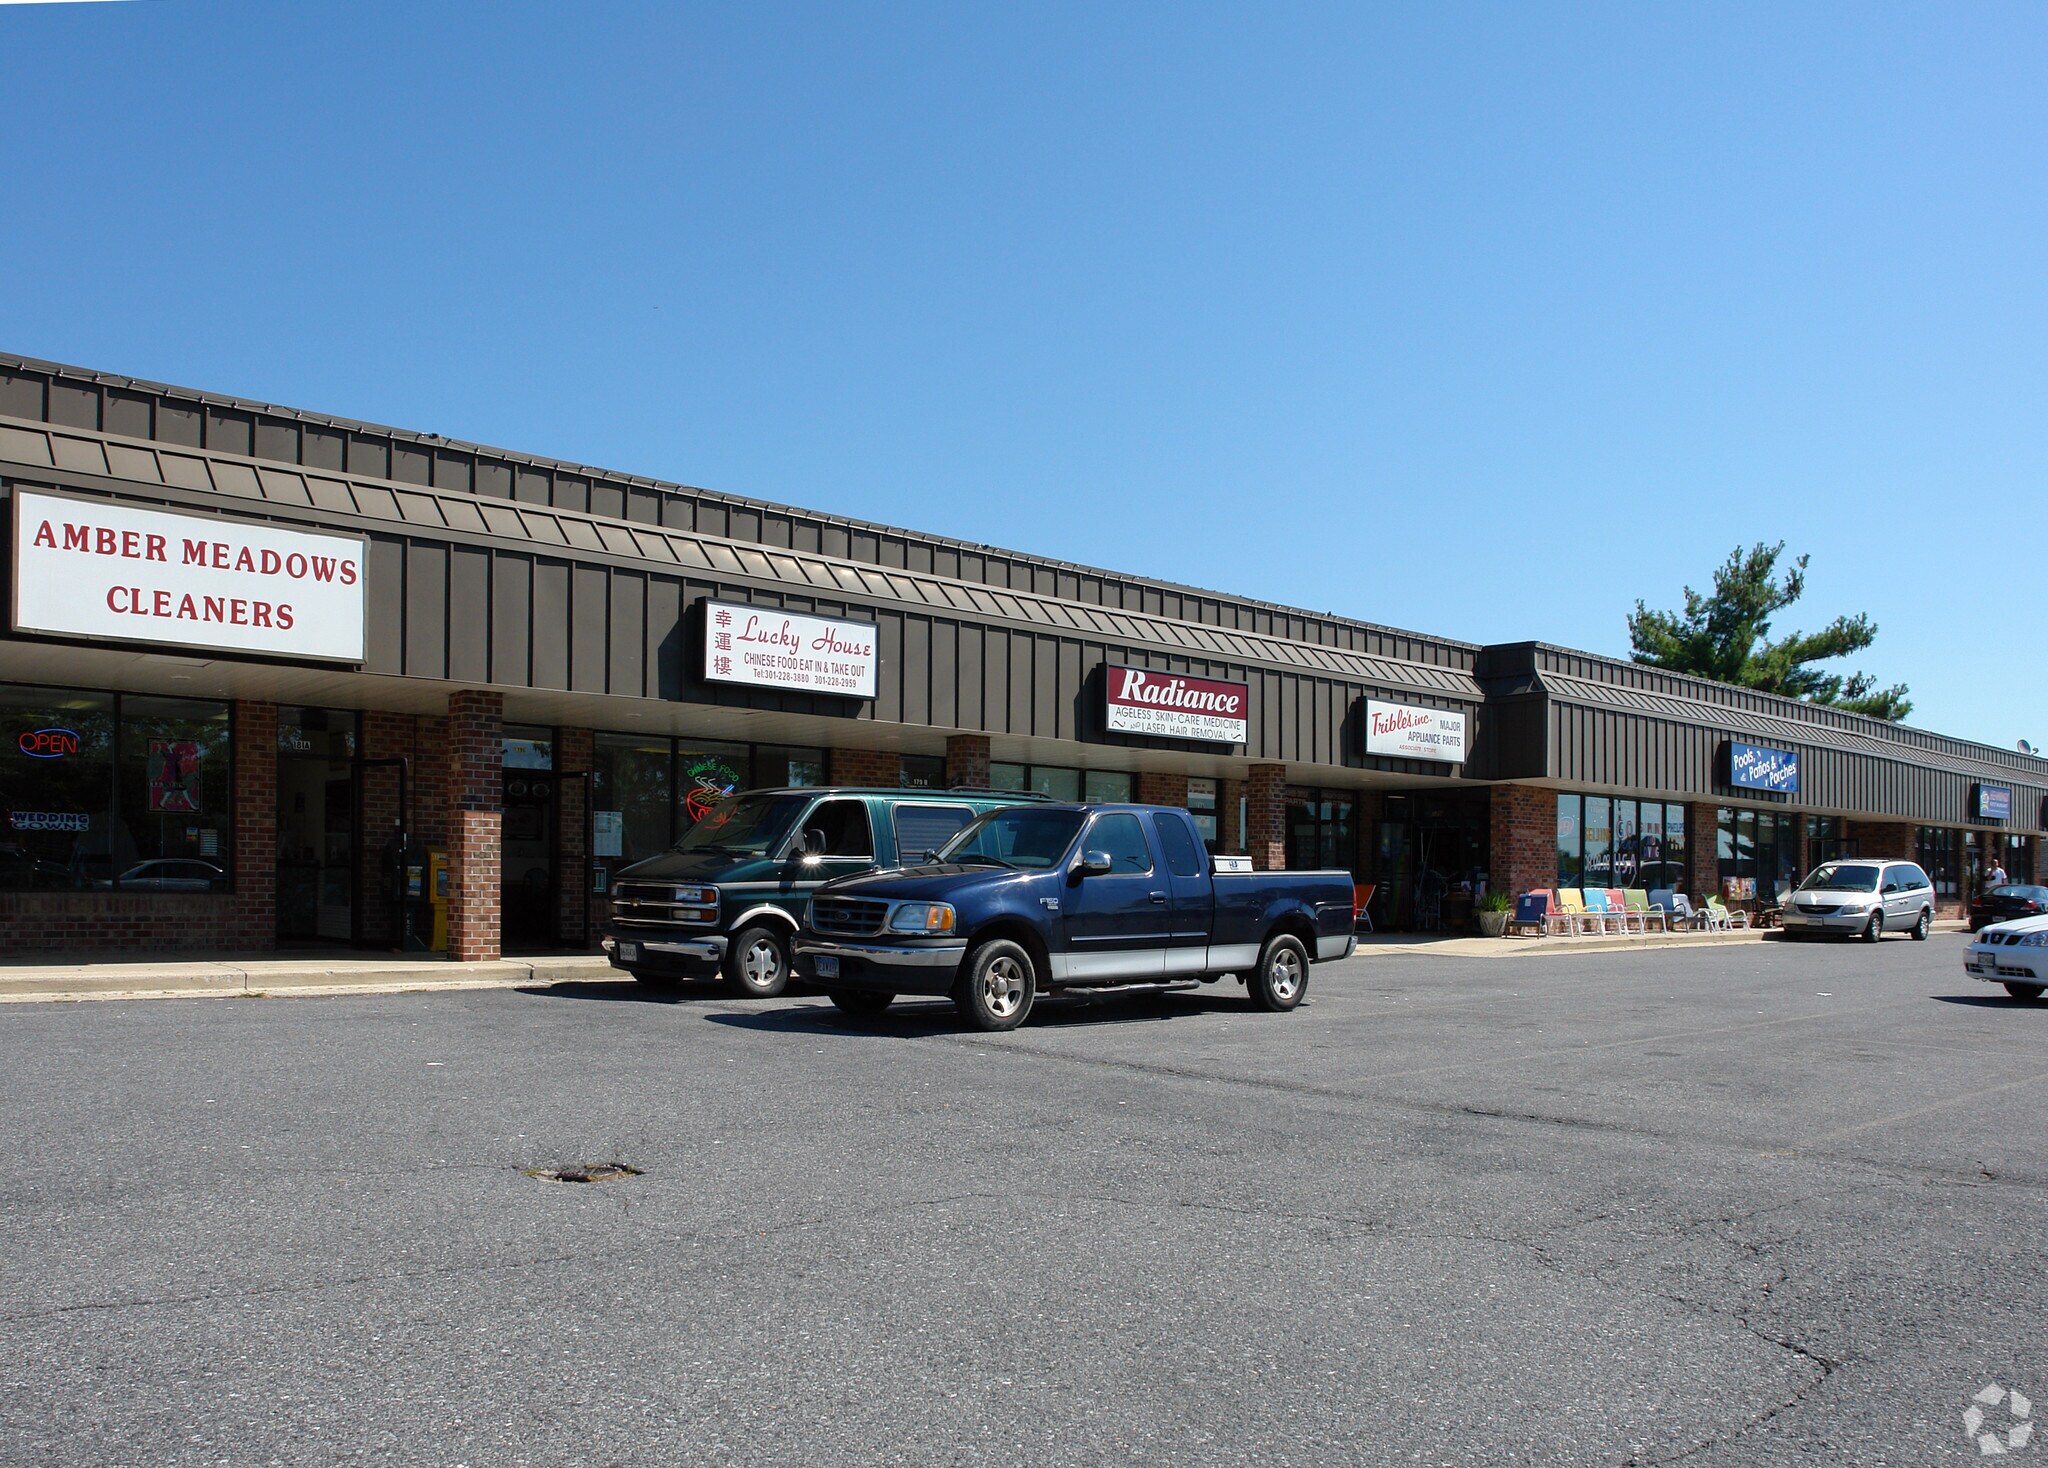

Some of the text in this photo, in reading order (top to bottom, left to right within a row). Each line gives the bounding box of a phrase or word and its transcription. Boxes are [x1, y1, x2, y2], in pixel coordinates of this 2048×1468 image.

[33, 519, 358, 586] AMBER MEADOWS
[106, 585, 295, 631] CLEANERS
[713, 609, 732, 676] 幸運樓
[737, 615, 872, 657] Lucky House
[744, 652, 865, 678] CHINESE FOOD EAT IN & TAKE OUT
[814, 675, 857, 688] 301-228-2959
[1117, 668, 1239, 713] Radiance
[1115, 707, 1241, 731] AGELESS SKIN-CARE MEDICINE
[1440, 719, 1461, 732] MAJOR
[19, 733, 78, 753] OPEN
[1141, 723, 1166, 733] LASER
[1170, 726, 1188, 736] HAIR
[1191, 728, 1227, 741] REMOVAL
[1407, 731, 1461, 747] APPLIANCE PARTS
[719, 764, 739, 782] FOOD
[1748, 760, 1771, 782] Patios
[1769, 762, 1797, 787] Porches
[13, 812, 89, 824] WEDDING
[13, 821, 88, 831] GOWNS
[1613, 853, 1638, 875] USA
